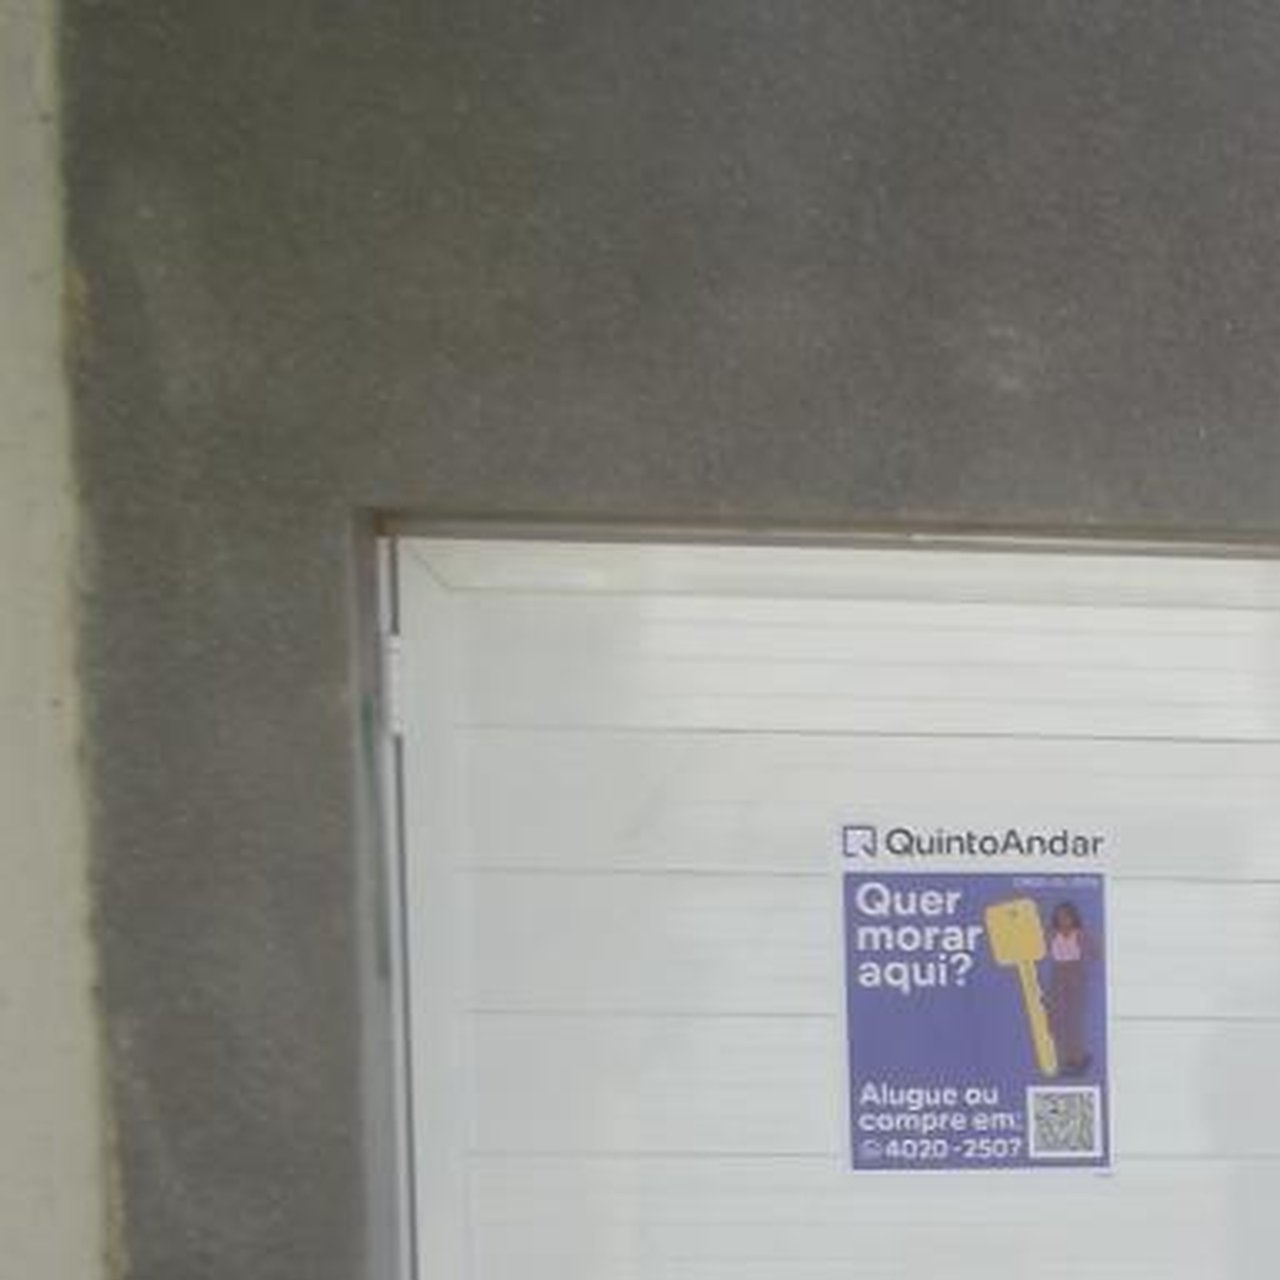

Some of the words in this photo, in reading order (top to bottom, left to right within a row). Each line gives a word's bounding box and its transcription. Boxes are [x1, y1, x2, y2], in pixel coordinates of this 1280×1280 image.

[885, 828, 1105, 857] QuintoAndar
[856, 882, 962, 916] Quer
[857, 924, 984, 951] morar
[858, 953, 974, 993] aqui?
[860, 1082, 957, 1111] Alugue
[964, 1087, 998, 1105] ou
[858, 1113, 967, 1134] compre
